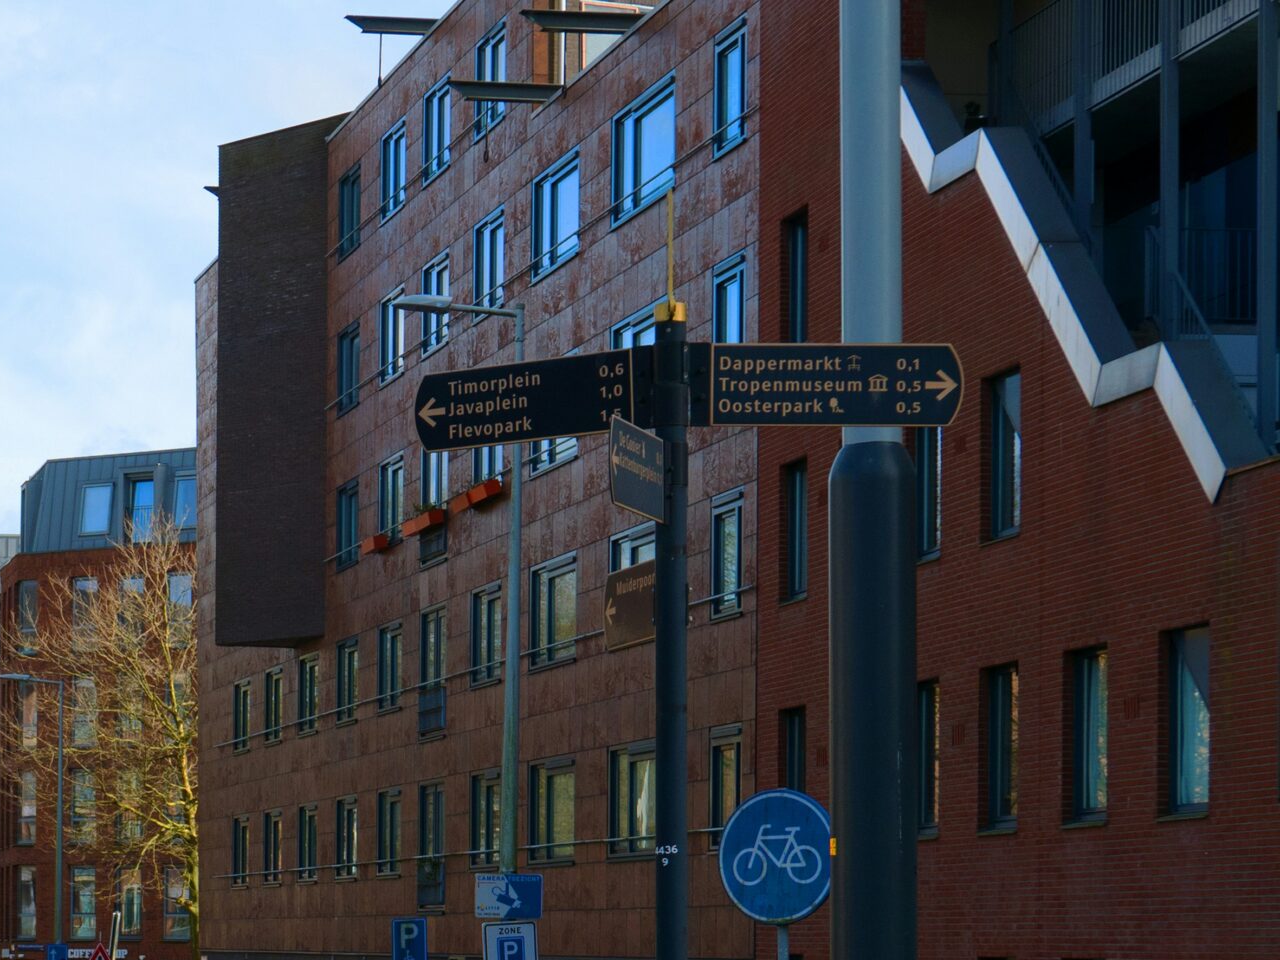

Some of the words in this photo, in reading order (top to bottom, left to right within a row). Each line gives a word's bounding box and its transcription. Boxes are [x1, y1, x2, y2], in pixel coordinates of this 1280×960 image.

[719, 355, 842, 374] Dappermarkt
[896, 358, 920, 373] 0,1
[448, 371, 541, 397] Timorplein
[599, 363, 624, 378] 0,6
[719, 377, 862, 395] Tropenmuseum
[896, 379, 921, 394] 0,5
[448, 394, 528, 419] Javaplein
[600, 384, 623, 399] 1,0
[718, 398, 823, 416] Oosterpark
[896, 401, 921, 416] 0,5
[449, 416, 532, 440] Flevopark
[662, 857, 669, 866] 9
[401, 923, 418, 949] P
[499, 927, 522, 935] ZONE
